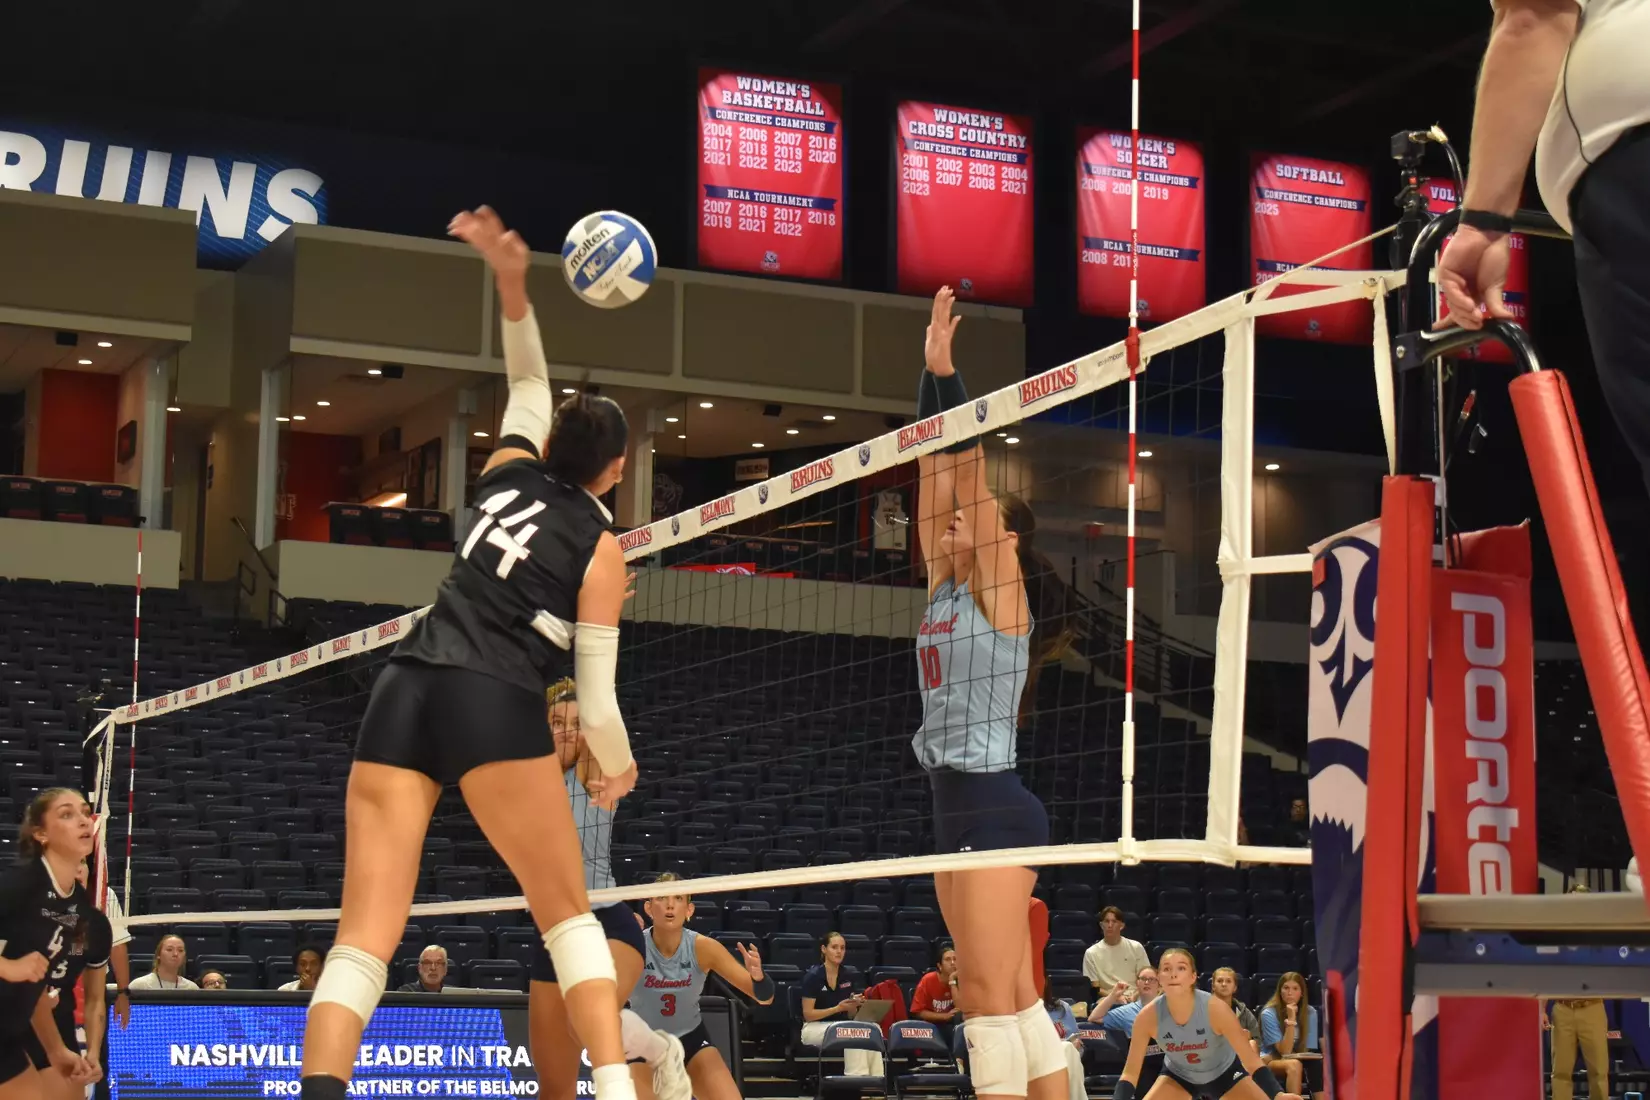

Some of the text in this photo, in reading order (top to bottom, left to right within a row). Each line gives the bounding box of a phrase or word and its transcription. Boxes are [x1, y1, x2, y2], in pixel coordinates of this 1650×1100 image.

[736, 76, 811, 98] WOMEN'S
[722, 90, 825, 116] BASKETBALL
[716, 109, 826, 132] CONFERENCE CHAMPIONS
[933, 108, 1003, 130] WOMEN'S
[704, 123, 837, 150] 2004 2006 2007 2016
[909, 121, 1027, 148] CROSS COUNTRY
[704, 137, 837, 164] 2017 2018 2019 2020
[913, 141, 1018, 163] CONFERENCE CHAMPIONS
[704, 152, 802, 173] 2021 2022 2023
[903, 153, 1028, 181] 2001 2002 2003 2004
[936, 171, 962, 186] 2007
[968, 176, 995, 190] 2008
[1001, 180, 1027, 195] 2021
[1091, 165, 1189, 187] CONFERENE CHAMPIONS
[1276, 164, 1344, 185] SOFTBALL
[727, 189, 814, 207] NCAA TOURNAMENT
[903, 181, 930, 196] 2023
[1112, 182, 1134, 196] 200
[1144, 186, 1169, 200] 2019
[1264, 189, 1357, 210] CONFERENCE CHAMPIONS
[703, 200, 836, 226] 2007 2016 2017 2018
[1255, 202, 1280, 216] 2025
[703, 214, 802, 236] 2019 2021 2022
[570, 228, 610, 270] molten
[583, 239, 620, 282] NCAA
[1103, 240, 1179, 258] NCAA TURNAMENT
[1020, 363, 1078, 405] BRUINS
[899, 415, 944, 449] BELMONT
[791, 458, 834, 490] BRUINS
[701, 496, 736, 521] BELMONT
[461, 489, 547, 580] 14
[620, 526, 652, 551] BRUINS
[920, 645, 942, 691] 10
[48, 926, 64, 959] 4
[644, 974, 692, 988] Belmont
[660, 994, 676, 1017] 3
[836, 1027, 872, 1039] BELMONT
[901, 1028, 933, 1039] BELMONT
[1080, 1029, 1107, 1040] ELMONT
[170, 1044, 302, 1067] NASHVILL
[451, 1045, 475, 1067] IN
[1166, 1039, 1208, 1053] Belmont
[347, 1080, 413, 1095] ARTNER
[417, 1080, 440, 1095] OF
[443, 1080, 477, 1095] THE
[480, 1080, 539, 1095] BELMO
